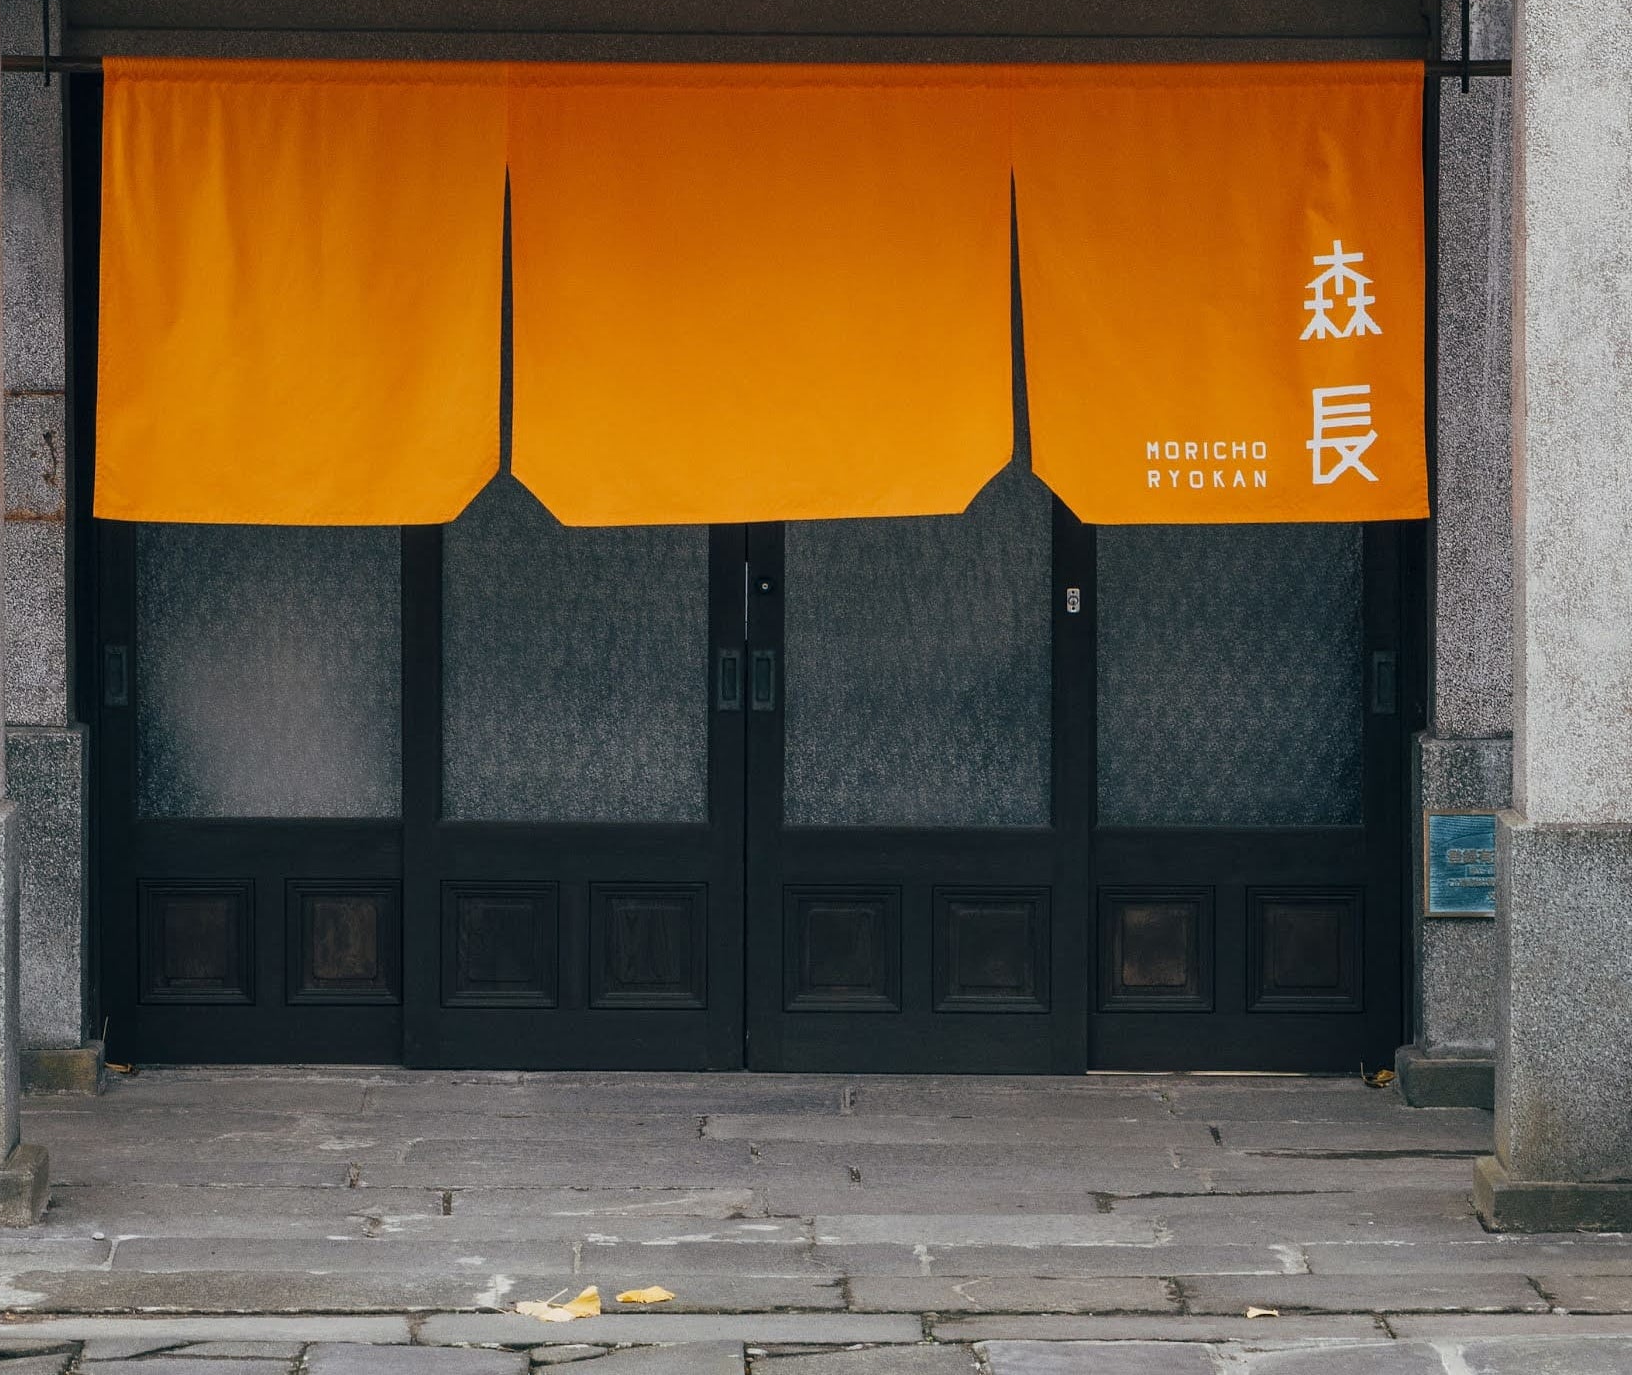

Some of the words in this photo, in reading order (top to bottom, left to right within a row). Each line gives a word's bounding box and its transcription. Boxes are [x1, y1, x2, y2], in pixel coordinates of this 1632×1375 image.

[1299, 240, 1382, 485] 森長
[1146, 441, 1267, 460] MORICHO
[1147, 470, 1267, 488] RYOKAN
